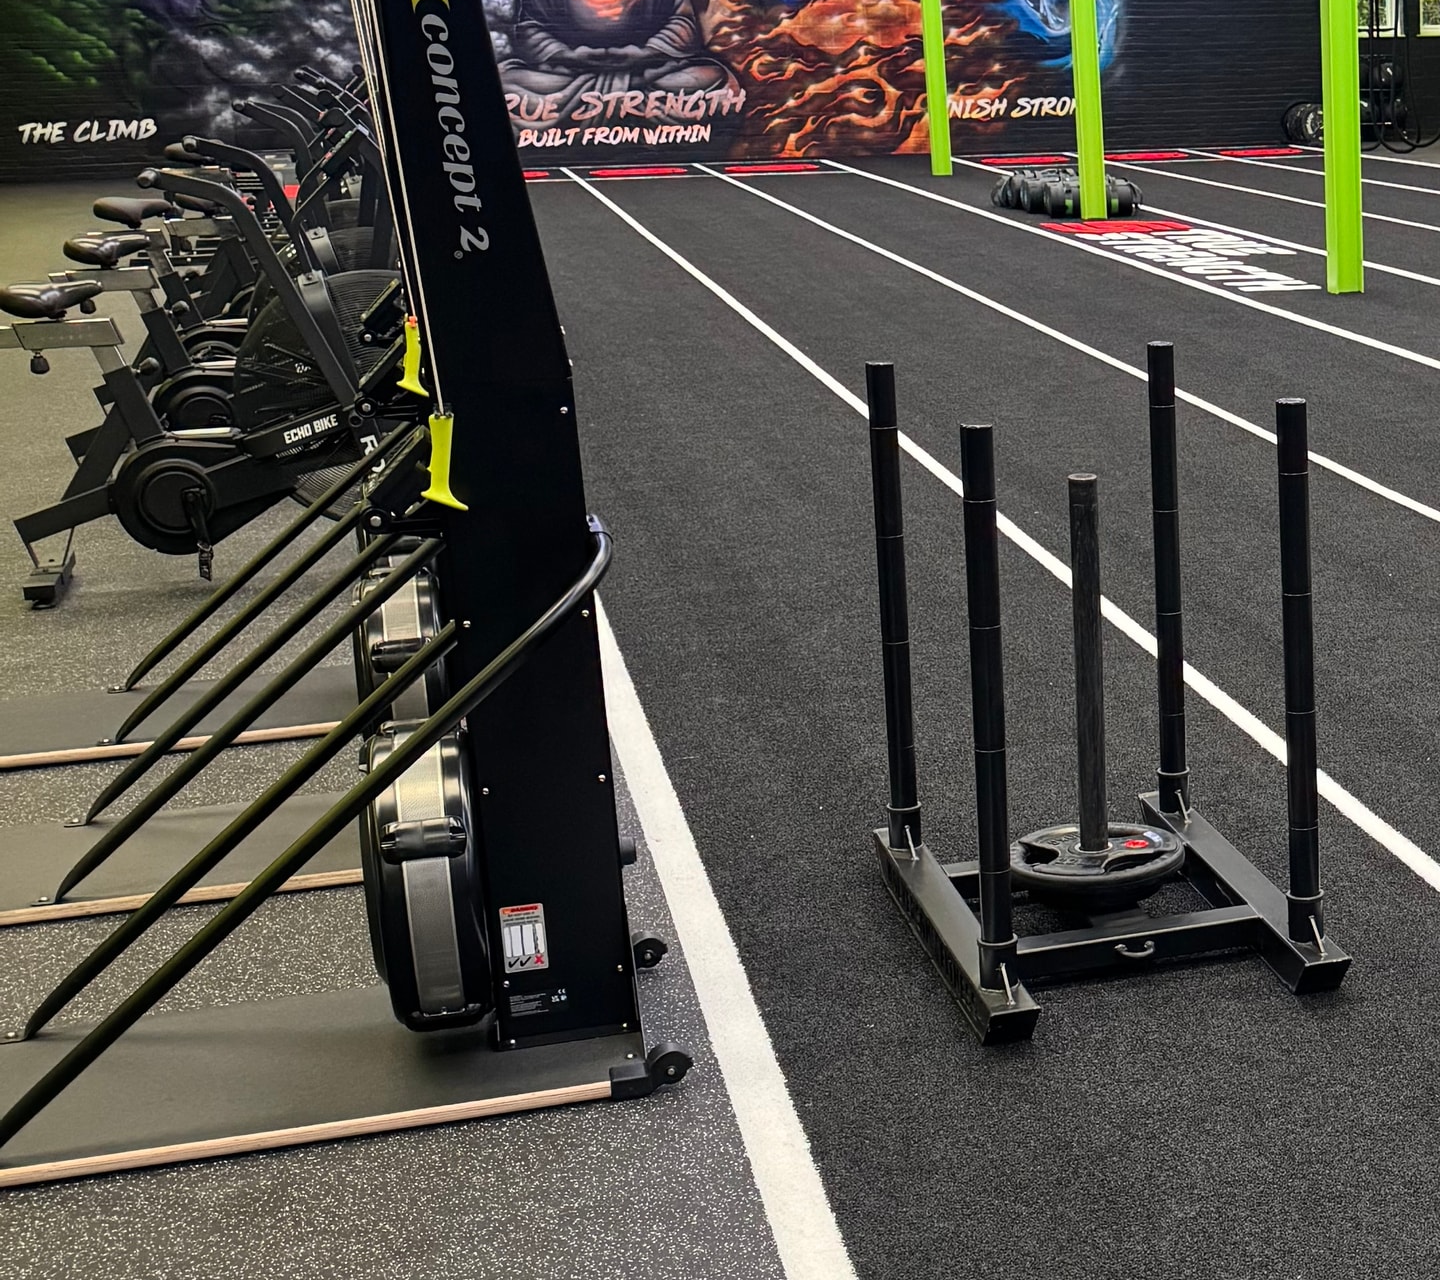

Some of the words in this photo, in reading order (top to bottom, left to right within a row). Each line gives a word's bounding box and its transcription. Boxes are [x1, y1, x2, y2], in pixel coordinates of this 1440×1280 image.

[421, 13, 483, 213] concept
[503, 92, 564, 121] RUE
[571, 88, 747, 121] STRENGTH
[948, 97, 1008, 119] NISH
[1010, 96, 1077, 119] STRO
[18, 121, 67, 144] THE
[73, 118, 158, 143] CLIMB
[517, 127, 581, 148] BUILT
[582, 125, 644, 146] FROM
[643, 123, 712, 146] WITHIN
[283, 422, 312, 445] ECHO
[313, 413, 339, 433] BIKE
